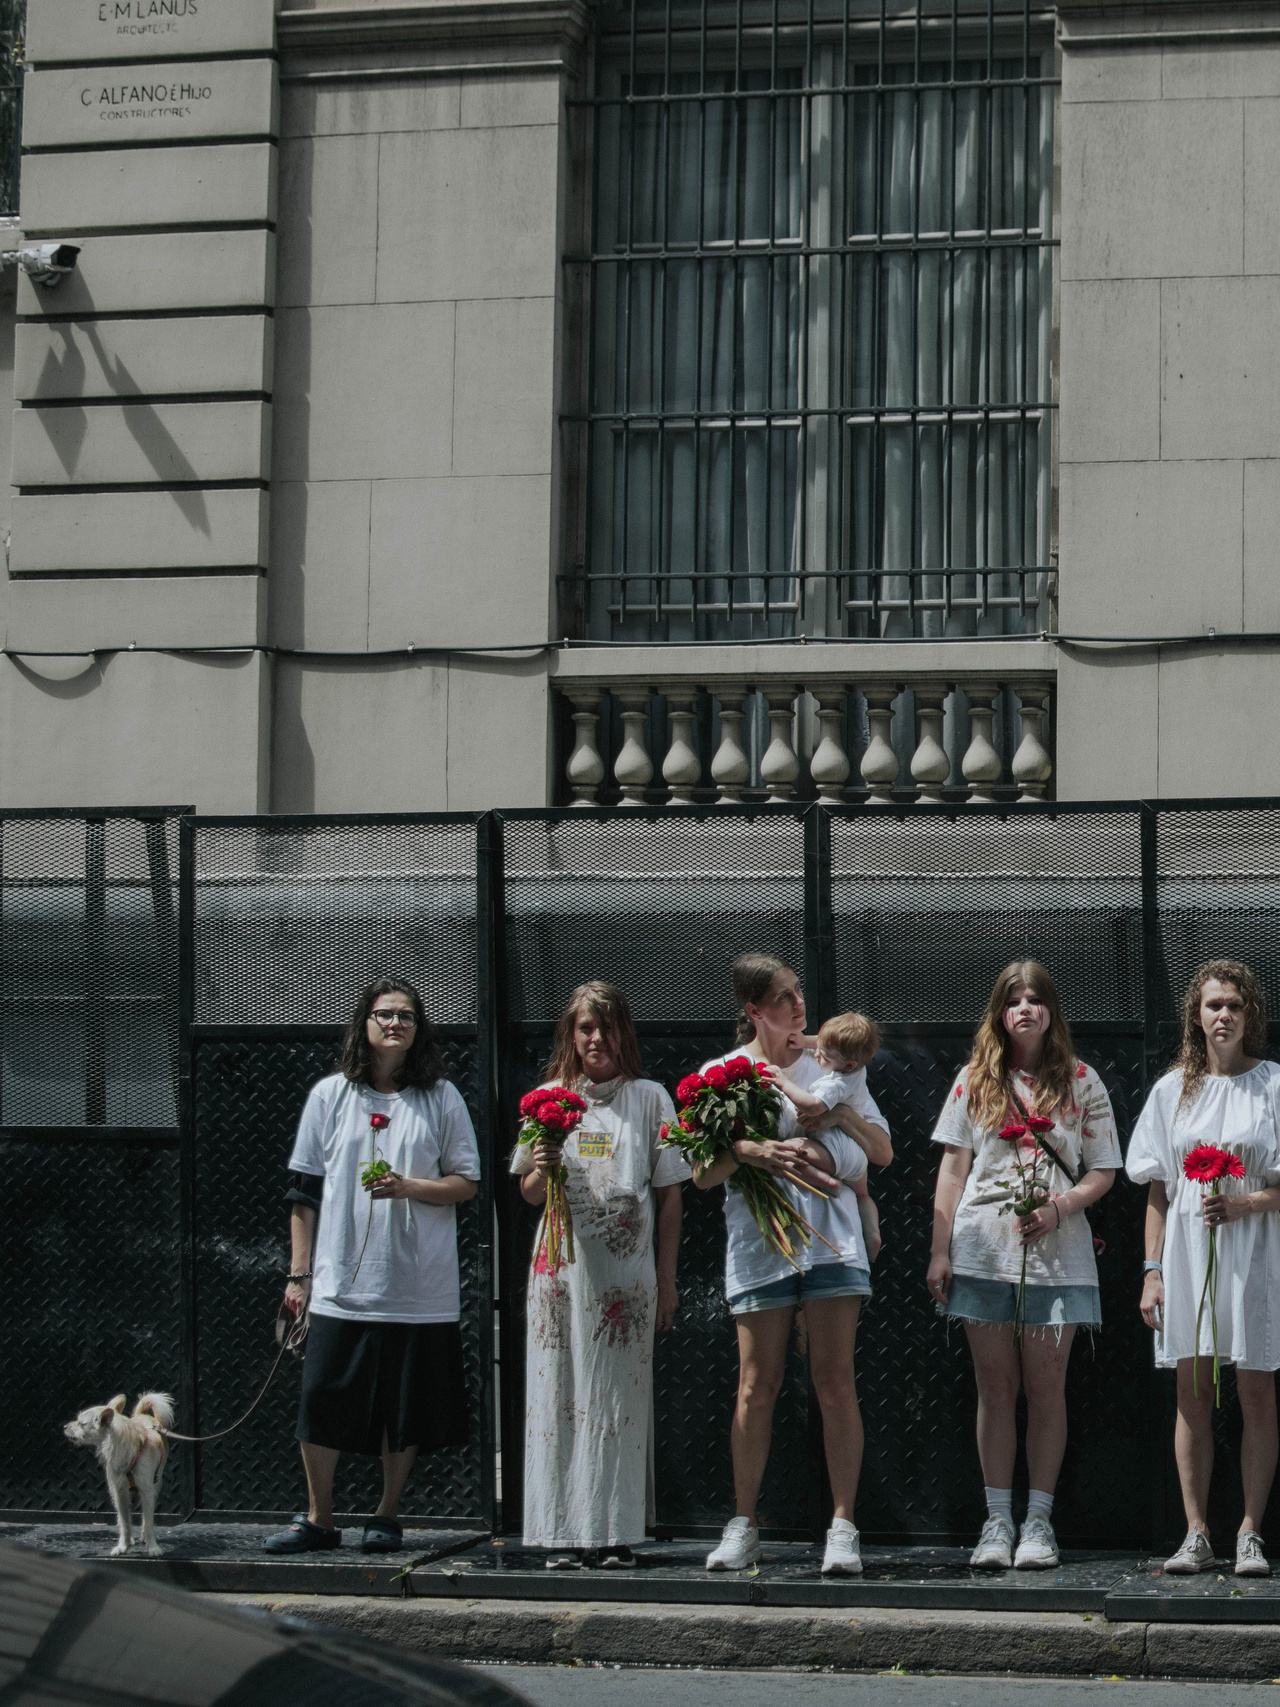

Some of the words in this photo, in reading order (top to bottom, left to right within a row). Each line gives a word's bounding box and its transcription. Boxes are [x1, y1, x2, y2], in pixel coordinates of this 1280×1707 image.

[99, 84, 168, 105] ALFANO
[100, 107, 191, 121] CONSTRUCTORES
[580, 1132, 614, 1143] FUCK
